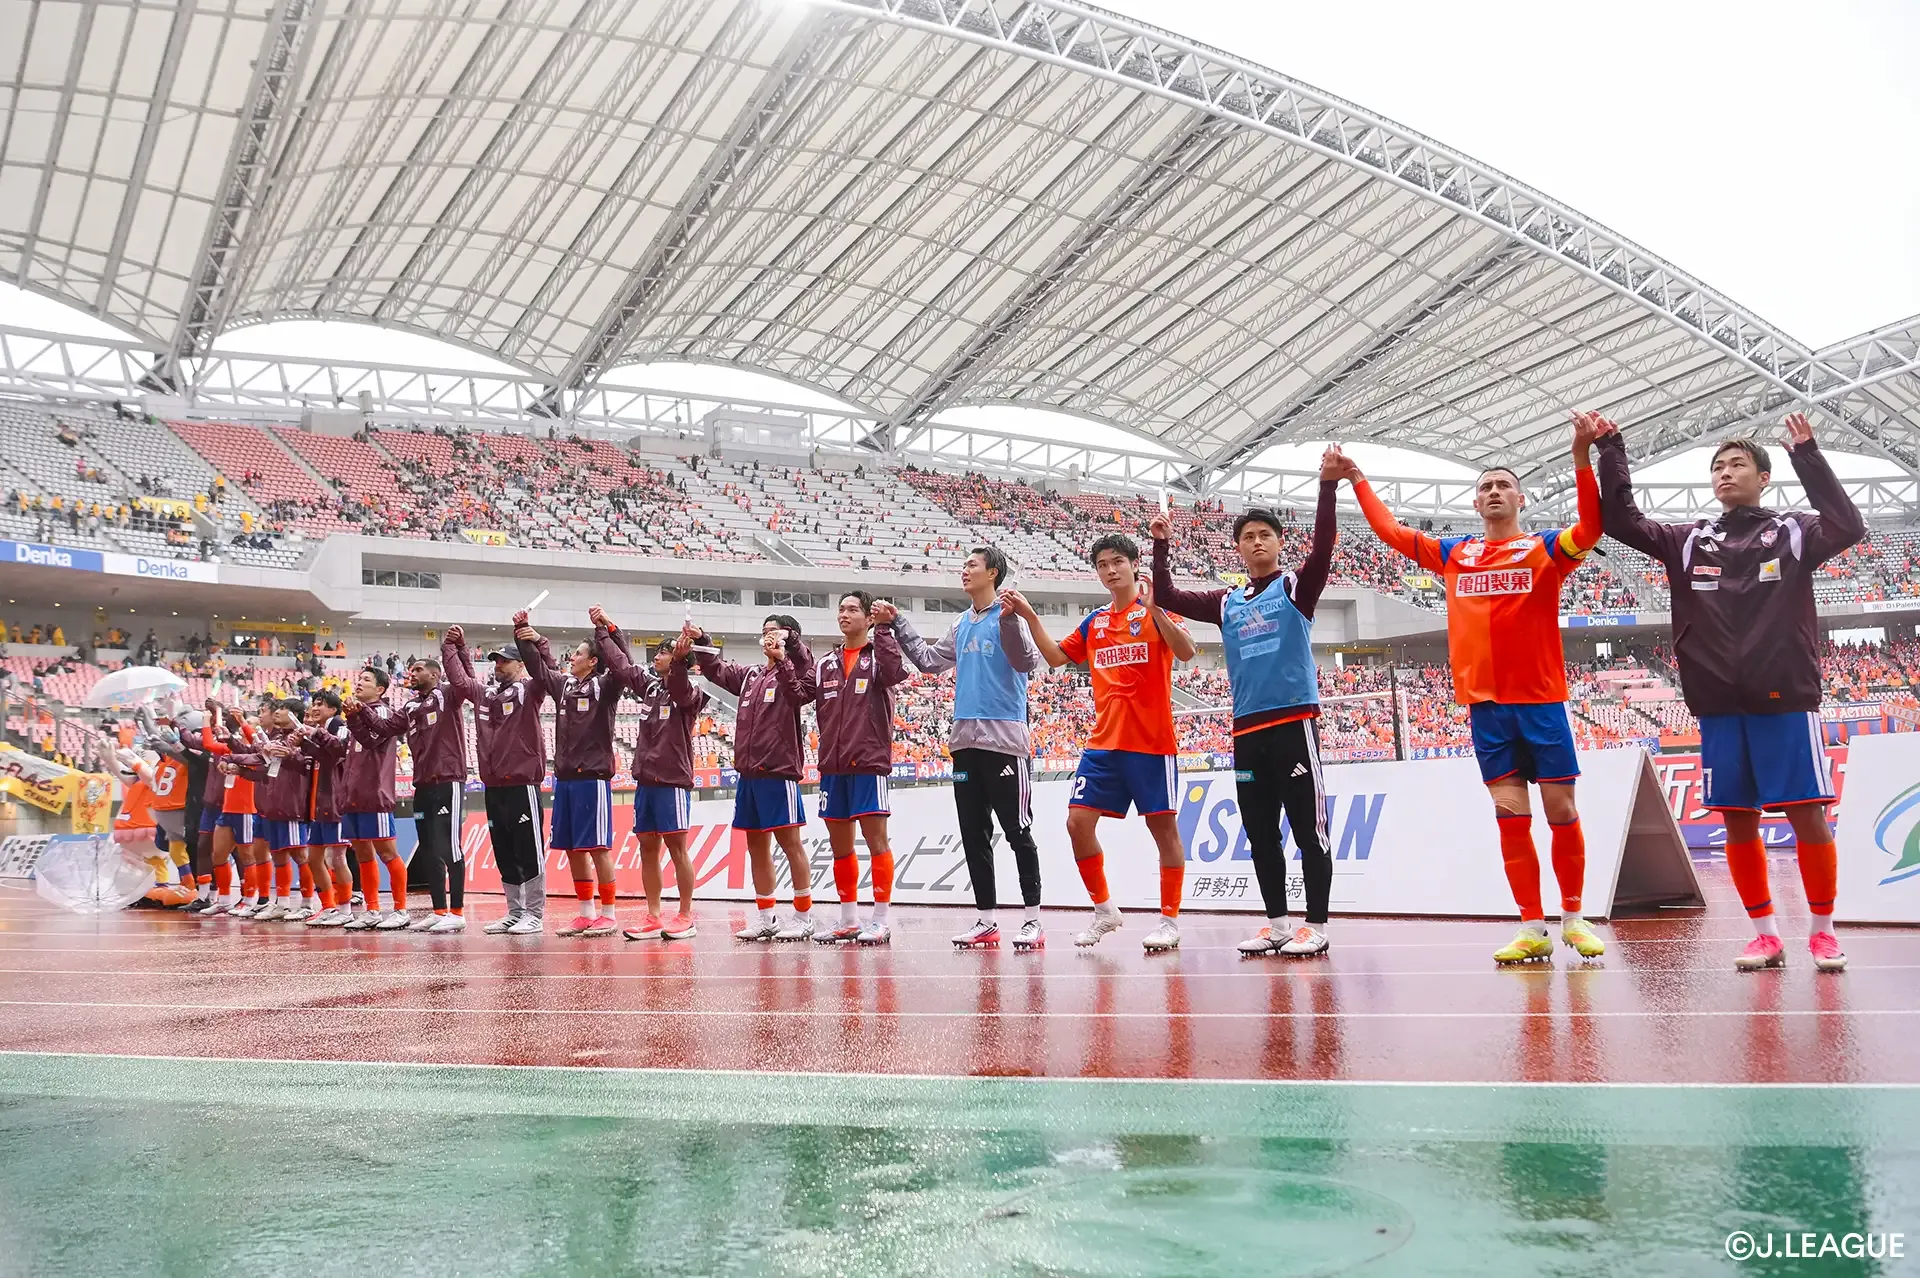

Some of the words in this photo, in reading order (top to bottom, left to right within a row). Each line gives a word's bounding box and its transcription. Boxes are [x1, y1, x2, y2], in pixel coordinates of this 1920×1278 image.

[15, 543, 72, 567] Denka
[137, 558, 188, 579] Denka
[1459, 572, 1531, 594] 亀田製菓
[1587, 616, 1618, 626] Denka
[1096, 645, 1147, 665] 亀田製菓
[1840, 705, 1880, 719] ACTION
[1192, 877, 1248, 897] 伊勢丹
